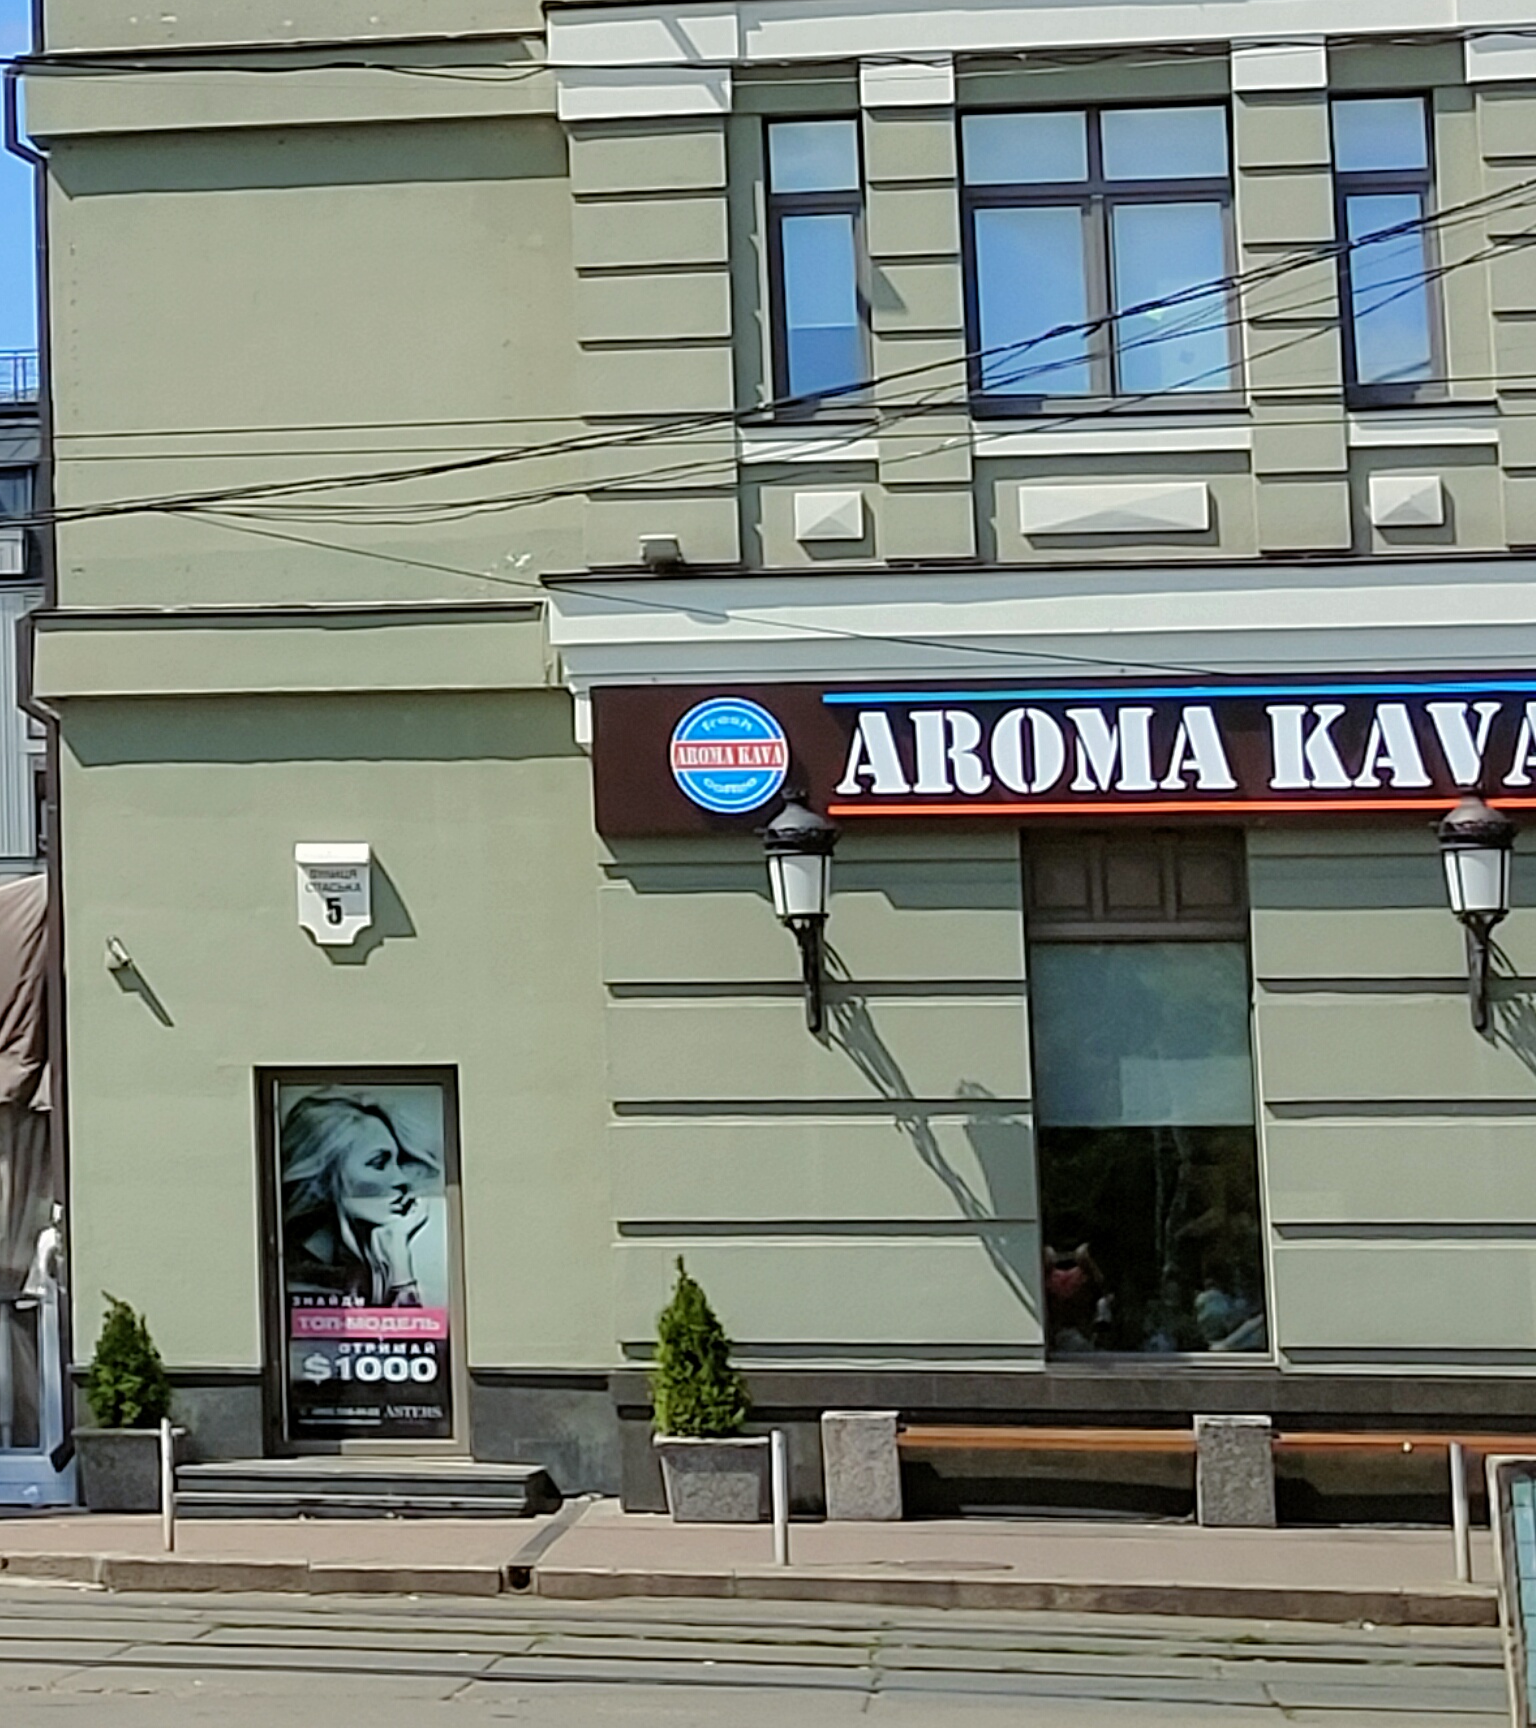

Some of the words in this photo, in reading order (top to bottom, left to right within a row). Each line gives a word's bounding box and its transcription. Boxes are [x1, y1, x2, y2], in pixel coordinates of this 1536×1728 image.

[677, 745, 735, 765] AROMA
[737, 744, 783, 765] KAVA
[834, 706, 1237, 796] AROMA
[326, 897, 342, 925] 5
[298, 1316, 440, 1332] ТОП-МОДЕЛЬ
[338, 1341, 435, 1354] ОТРИМАЙ
[304, 1352, 437, 1386] $1000
